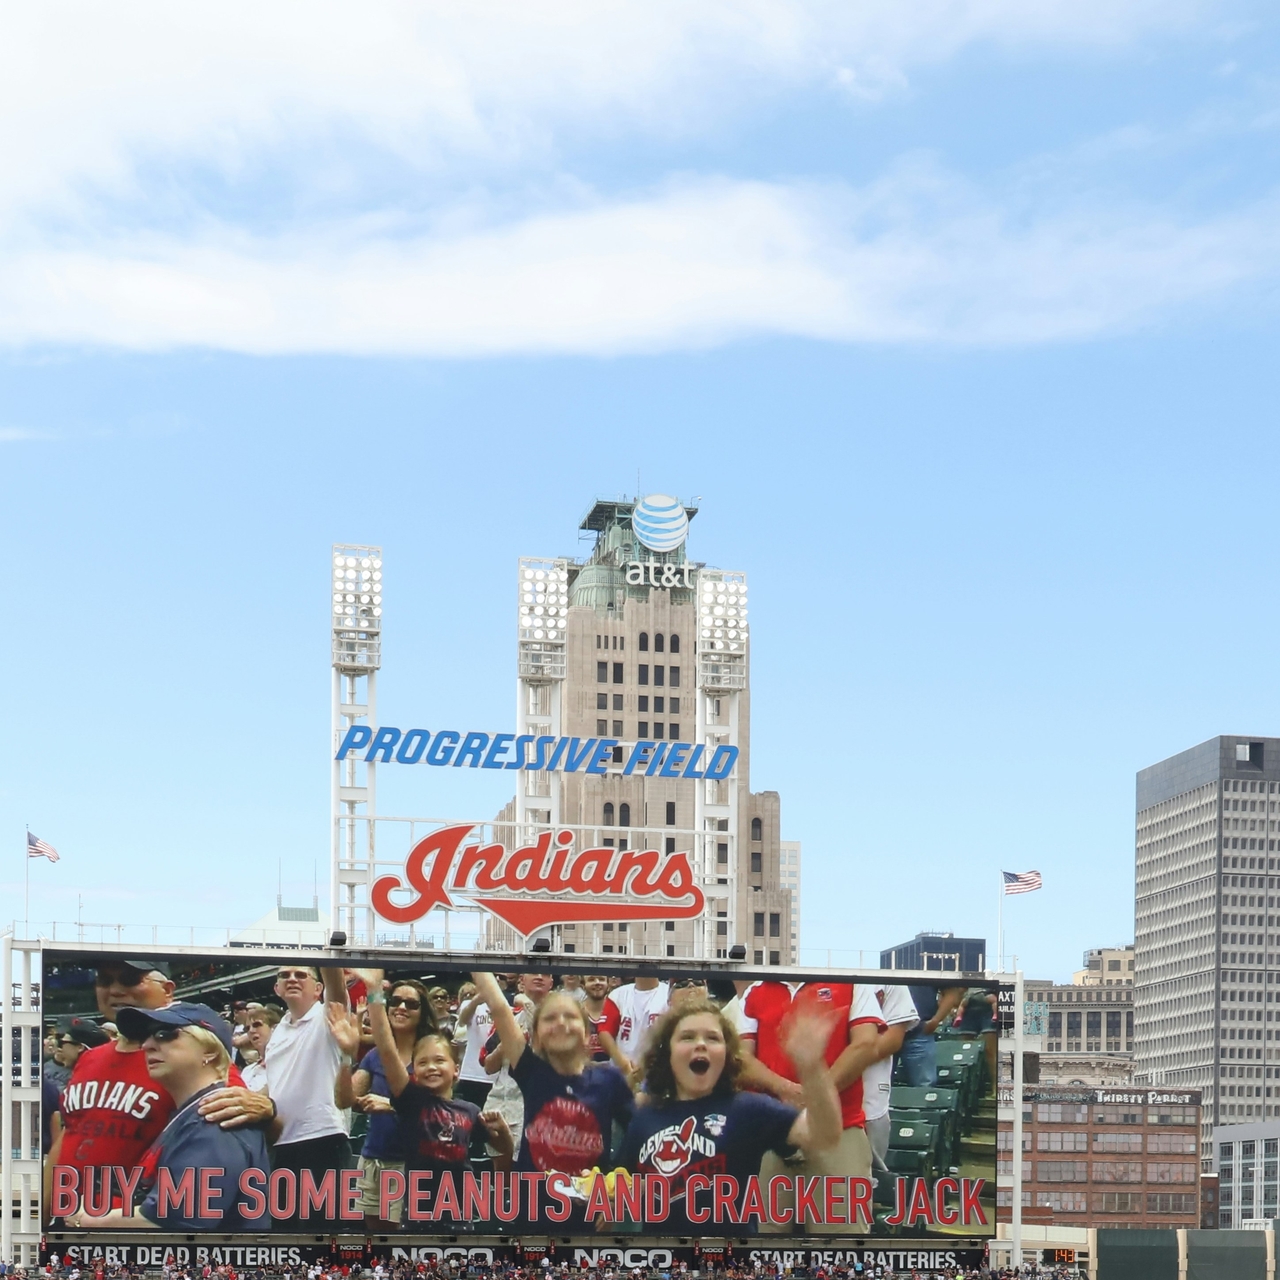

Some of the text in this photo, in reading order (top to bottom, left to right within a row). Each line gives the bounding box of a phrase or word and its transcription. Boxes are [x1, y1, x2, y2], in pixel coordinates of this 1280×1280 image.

[625, 556, 696, 589] at&t
[335, 725, 739, 780] PROGRESSIVE FIELD
[371, 823, 705, 926] Indians
[1148, 1091, 1191, 1104] PARROT
[50, 1165, 989, 1226] BUY ME SOME PEANUTS AND CRACKER JACK
[68, 1245, 131, 1265] START
[137, 1246, 190, 1265] DEAD
[340, 1251, 363, 1259] 1914
[392, 1248, 493, 1268] NOCO
[574, 1248, 673, 1268] NOCO
[750, 1250, 803, 1268] START
[1054, 1249, 1075, 1262] 1:43
